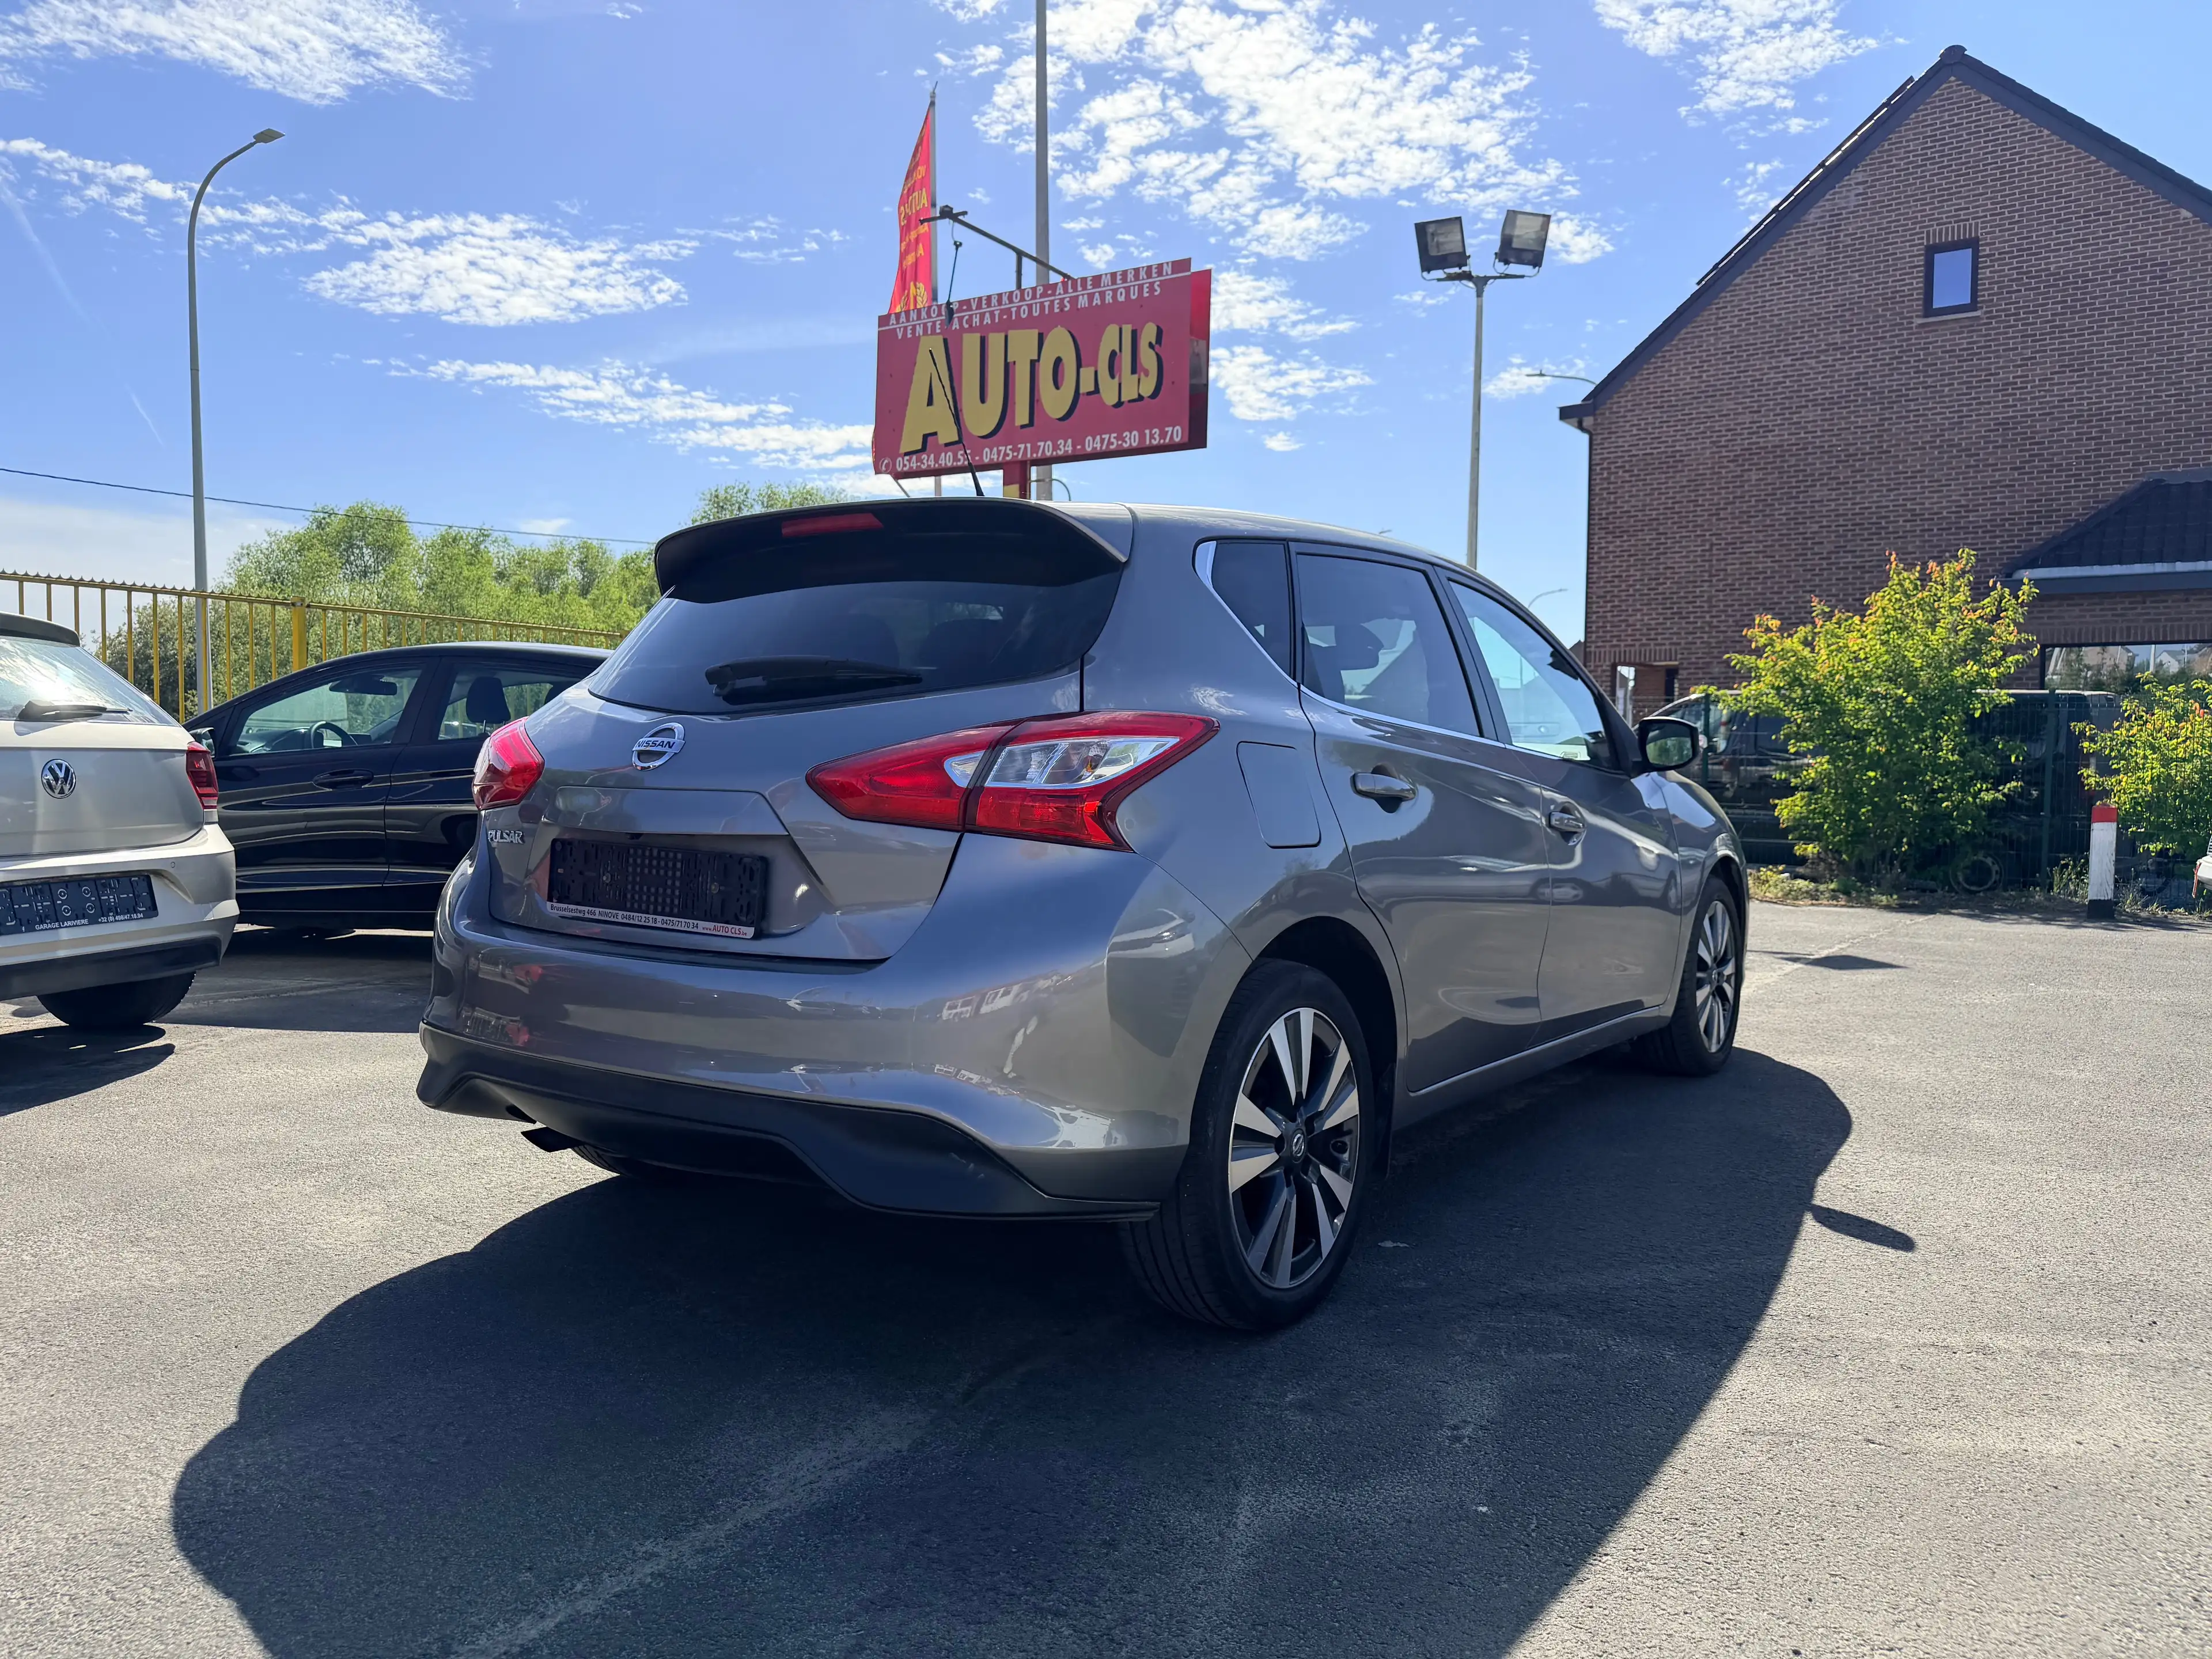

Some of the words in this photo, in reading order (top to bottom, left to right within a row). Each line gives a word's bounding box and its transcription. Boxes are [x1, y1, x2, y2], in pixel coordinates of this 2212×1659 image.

[1101, 262, 1172, 287] MERKEN
[1078, 281, 1161, 308] MARQUES
[899, 322, 1162, 454] AUTO-CLS
[896, 450, 971, 471] 054-34.40.55
[983, 438, 1073, 462] 0475-71.70.34
[1085, 431, 1139, 451] 0475-30
[1145, 426, 1181, 444] 13.70
[635, 740, 675, 749] NISSAN
[488, 830, 523, 844] PULSAR
[60, 919, 89, 927] LARIVIERE
[551, 904, 586, 916] Brusselsestwg
[598, 910, 619, 920] NINOVE
[661, 918, 683, 927] 0475/71
